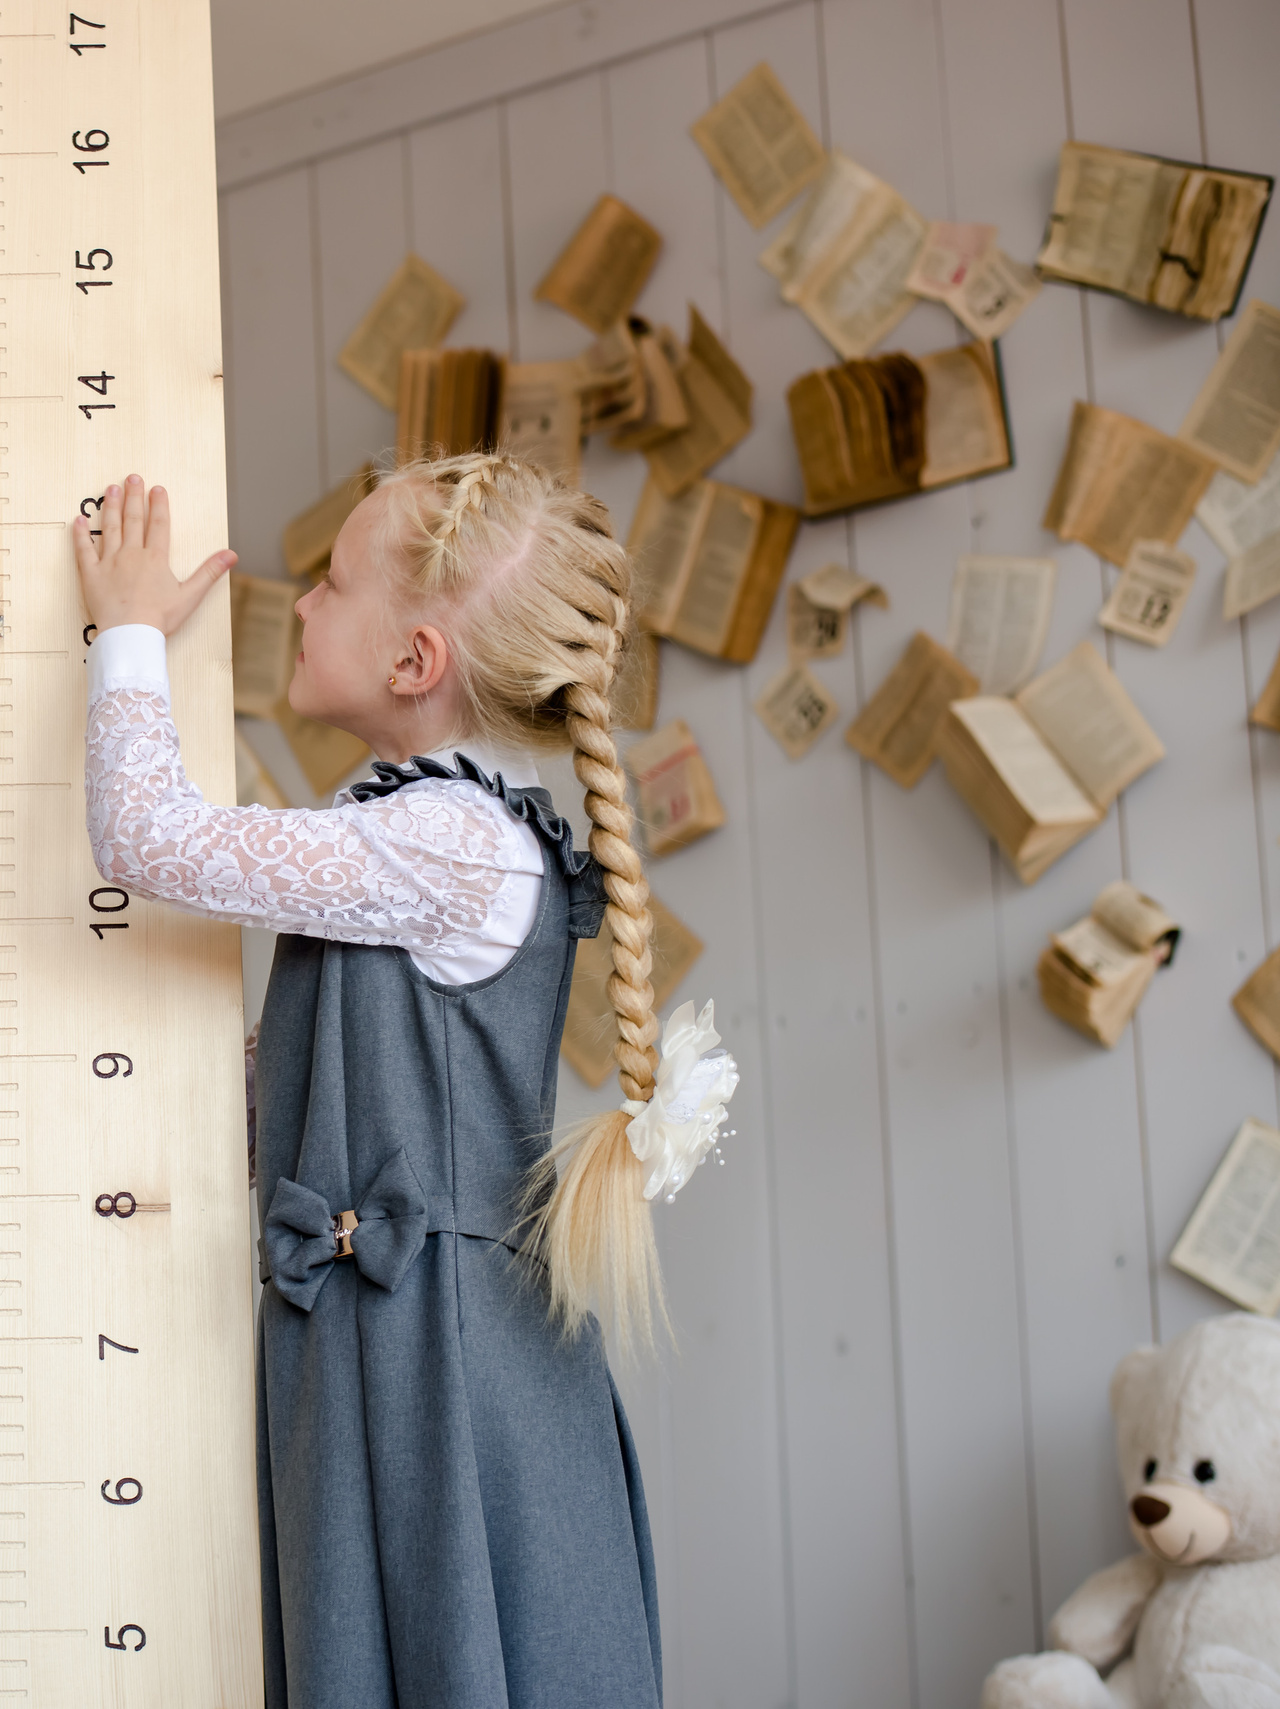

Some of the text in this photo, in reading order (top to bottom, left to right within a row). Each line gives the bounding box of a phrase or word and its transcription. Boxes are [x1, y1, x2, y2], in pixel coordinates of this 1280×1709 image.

[69, 13, 107, 57] 17
[72, 129, 110, 175] 16
[75, 248, 113, 295] 15
[77, 370, 116, 420] 14
[88, 886, 130, 940] 10
[92, 1052, 133, 1079] 9
[94, 1191, 139, 1219] 8
[98, 1334, 139, 1361] 7
[100, 1477, 143, 1505] 6
[104, 1623, 146, 1652] 5
